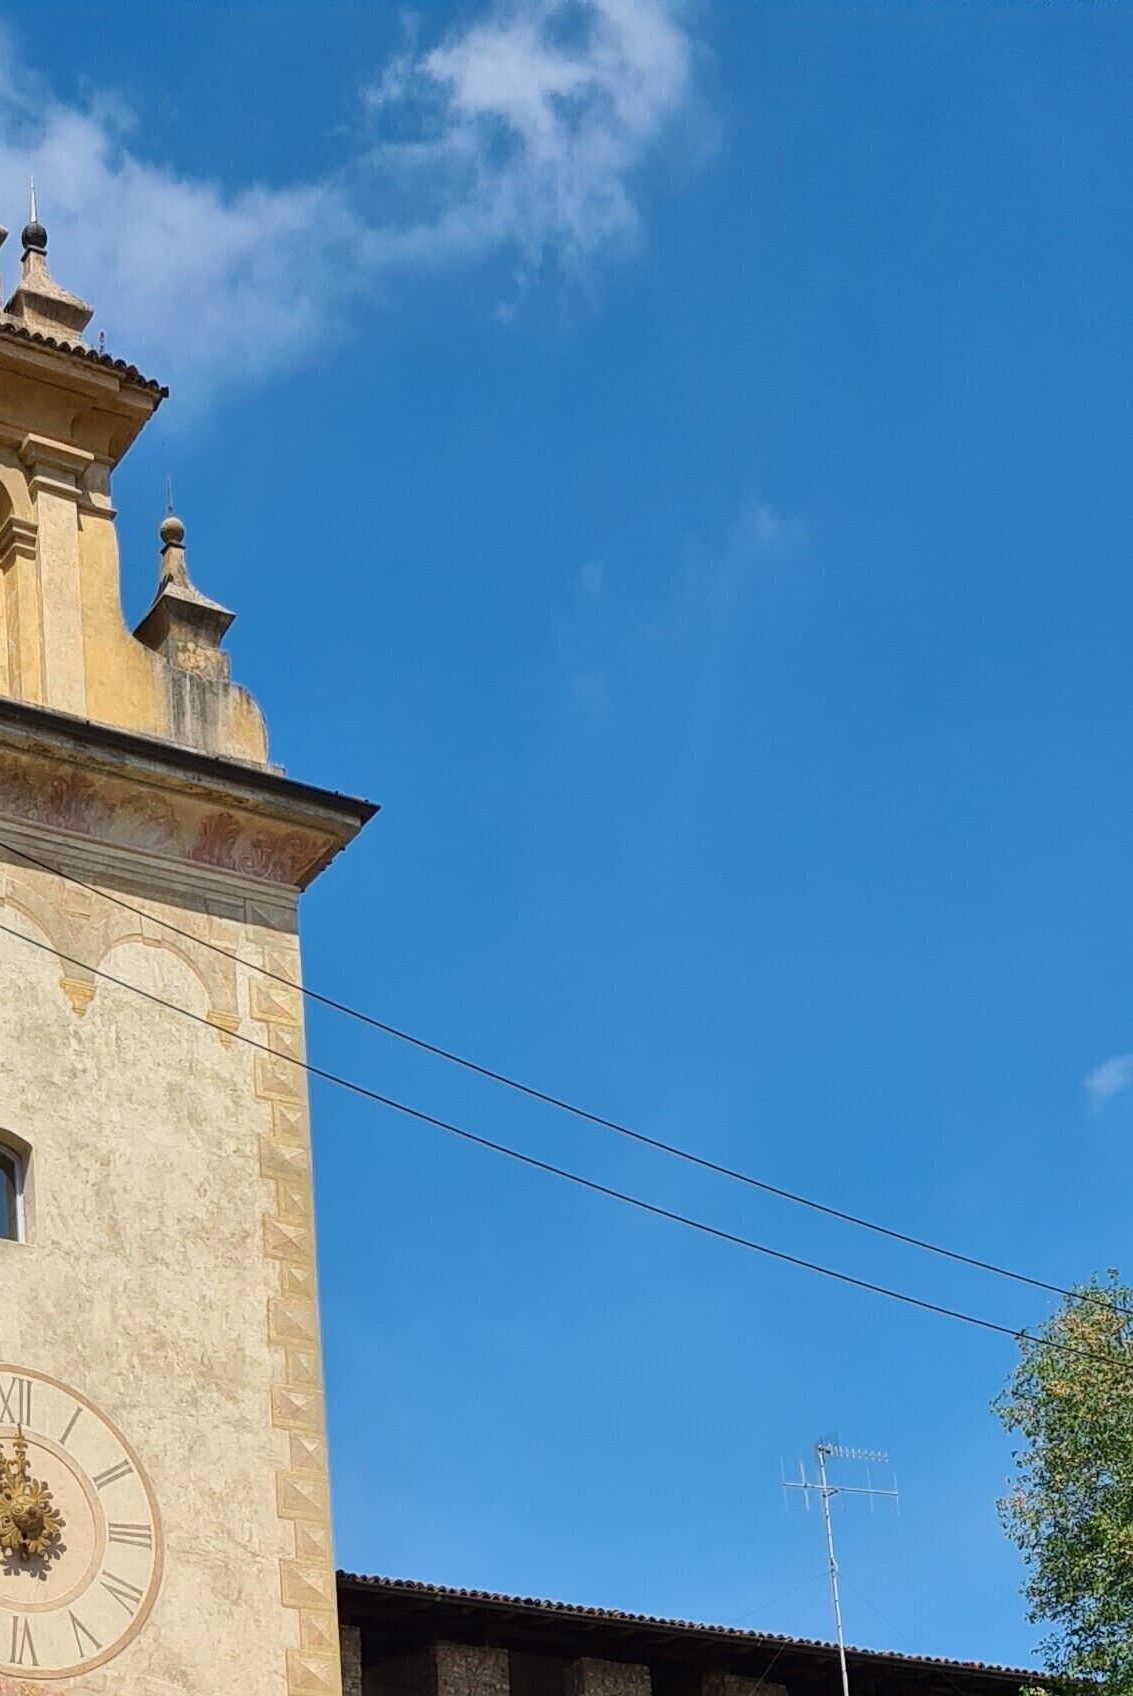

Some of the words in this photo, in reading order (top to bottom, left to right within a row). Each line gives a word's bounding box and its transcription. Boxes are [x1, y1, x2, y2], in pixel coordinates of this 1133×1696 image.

[59, 1406, 83, 1445] I
[92, 1459, 134, 1490] II
[108, 1521, 153, 1551] III
[99, 1568, 144, 1616] IV
[9, 1615, 40, 1667] VI
[68, 1608, 103, 1658] V
